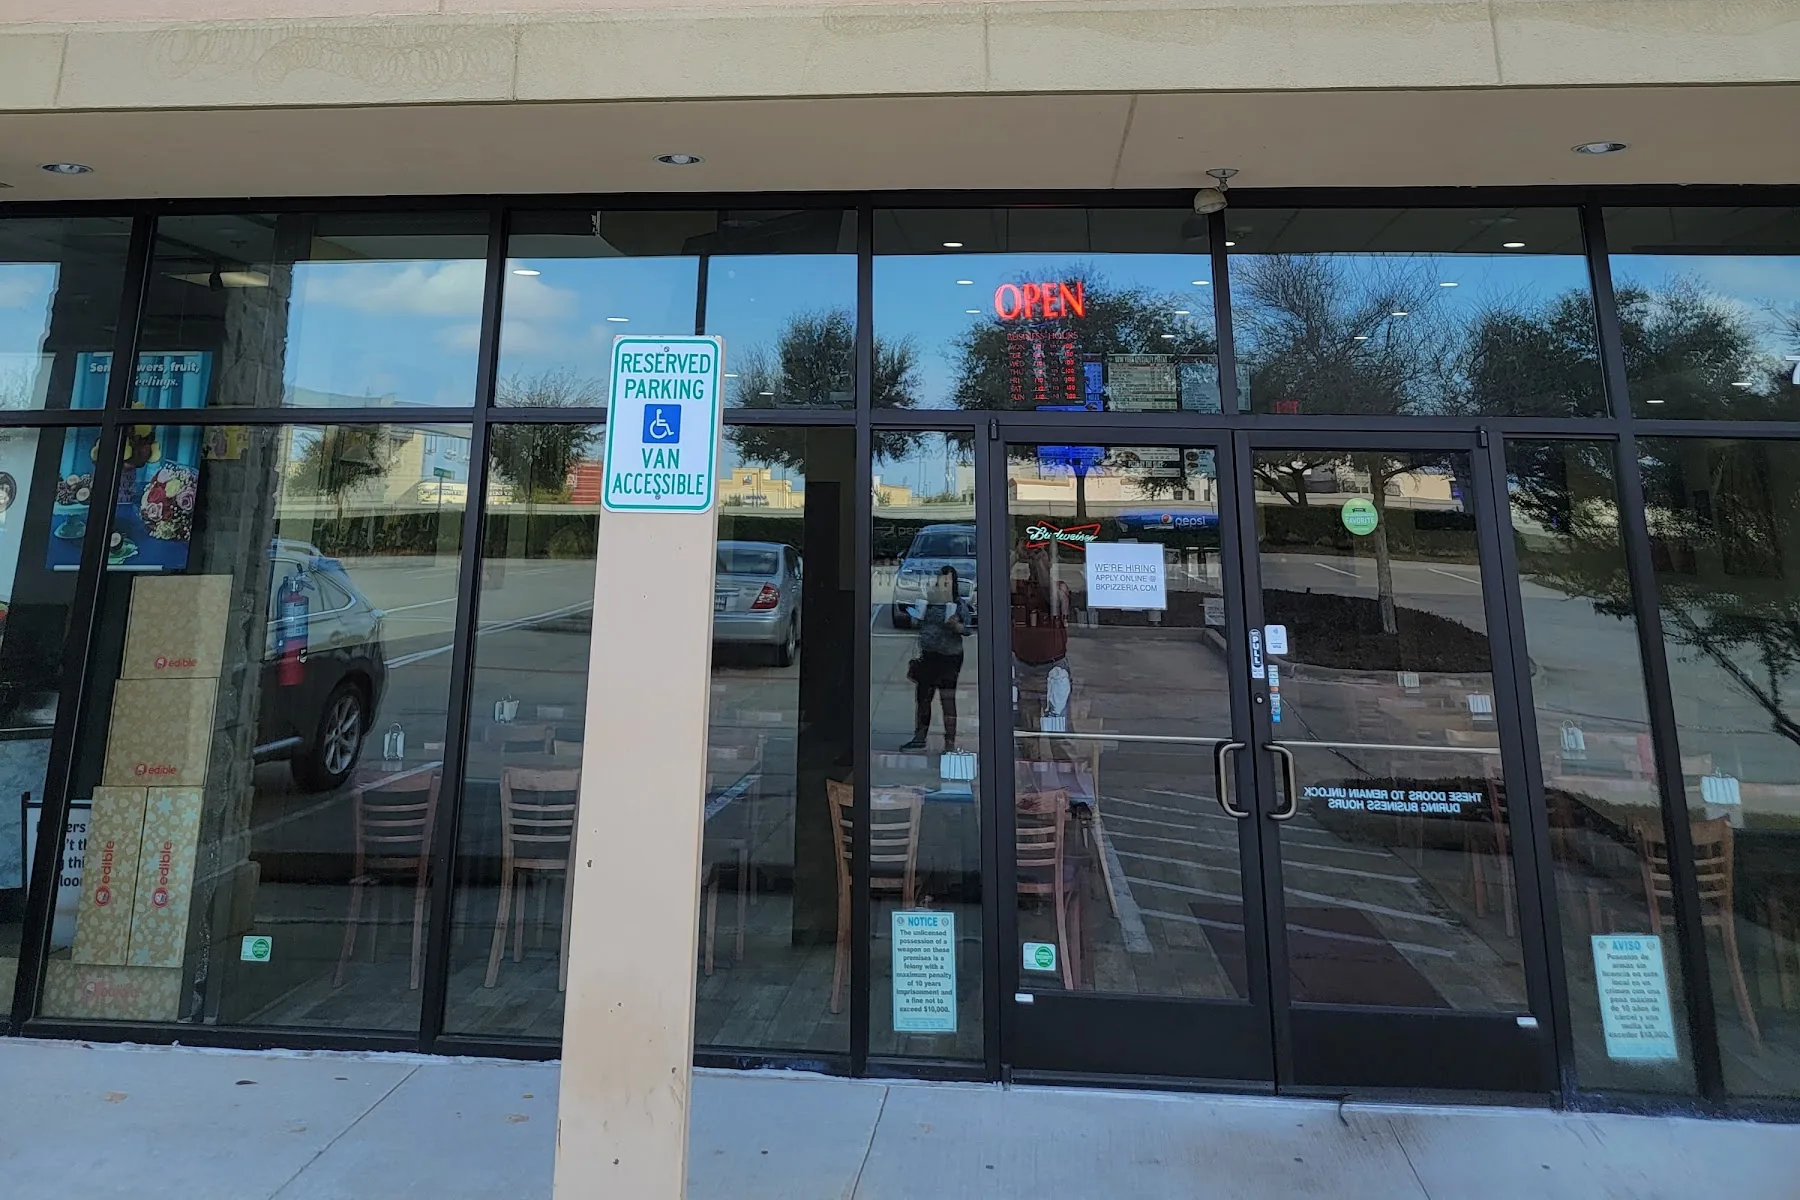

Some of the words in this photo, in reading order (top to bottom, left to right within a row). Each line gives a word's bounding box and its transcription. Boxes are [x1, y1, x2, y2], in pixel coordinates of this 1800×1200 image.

[994, 281, 1085, 319] OPEN
[169, 361, 200, 373] fruit,
[621, 353, 711, 374] RESERVED
[624, 379, 704, 400] PARKING
[642, 448, 679, 469] VAN
[612, 473, 704, 495] ACCESSIBLE
[1175, 515, 1206, 529] pepsi
[1026, 526, 1099, 542] Budweiser
[1095, 563, 1123, 572] WE'RE
[1125, 563, 1156, 573] HIRING
[1095, 574, 1118, 582] APPLY
[1120, 575, 1147, 583] ONLINE
[1095, 583, 1158, 592] BKPIZZERIA.COM
[168, 657, 197, 668] edible
[148, 764, 177, 775] edible
[101, 840, 115, 885] edible
[159, 840, 173, 886] edible
[907, 916, 938, 927] NOTICE
[1612, 940, 1641, 951] AVISO
